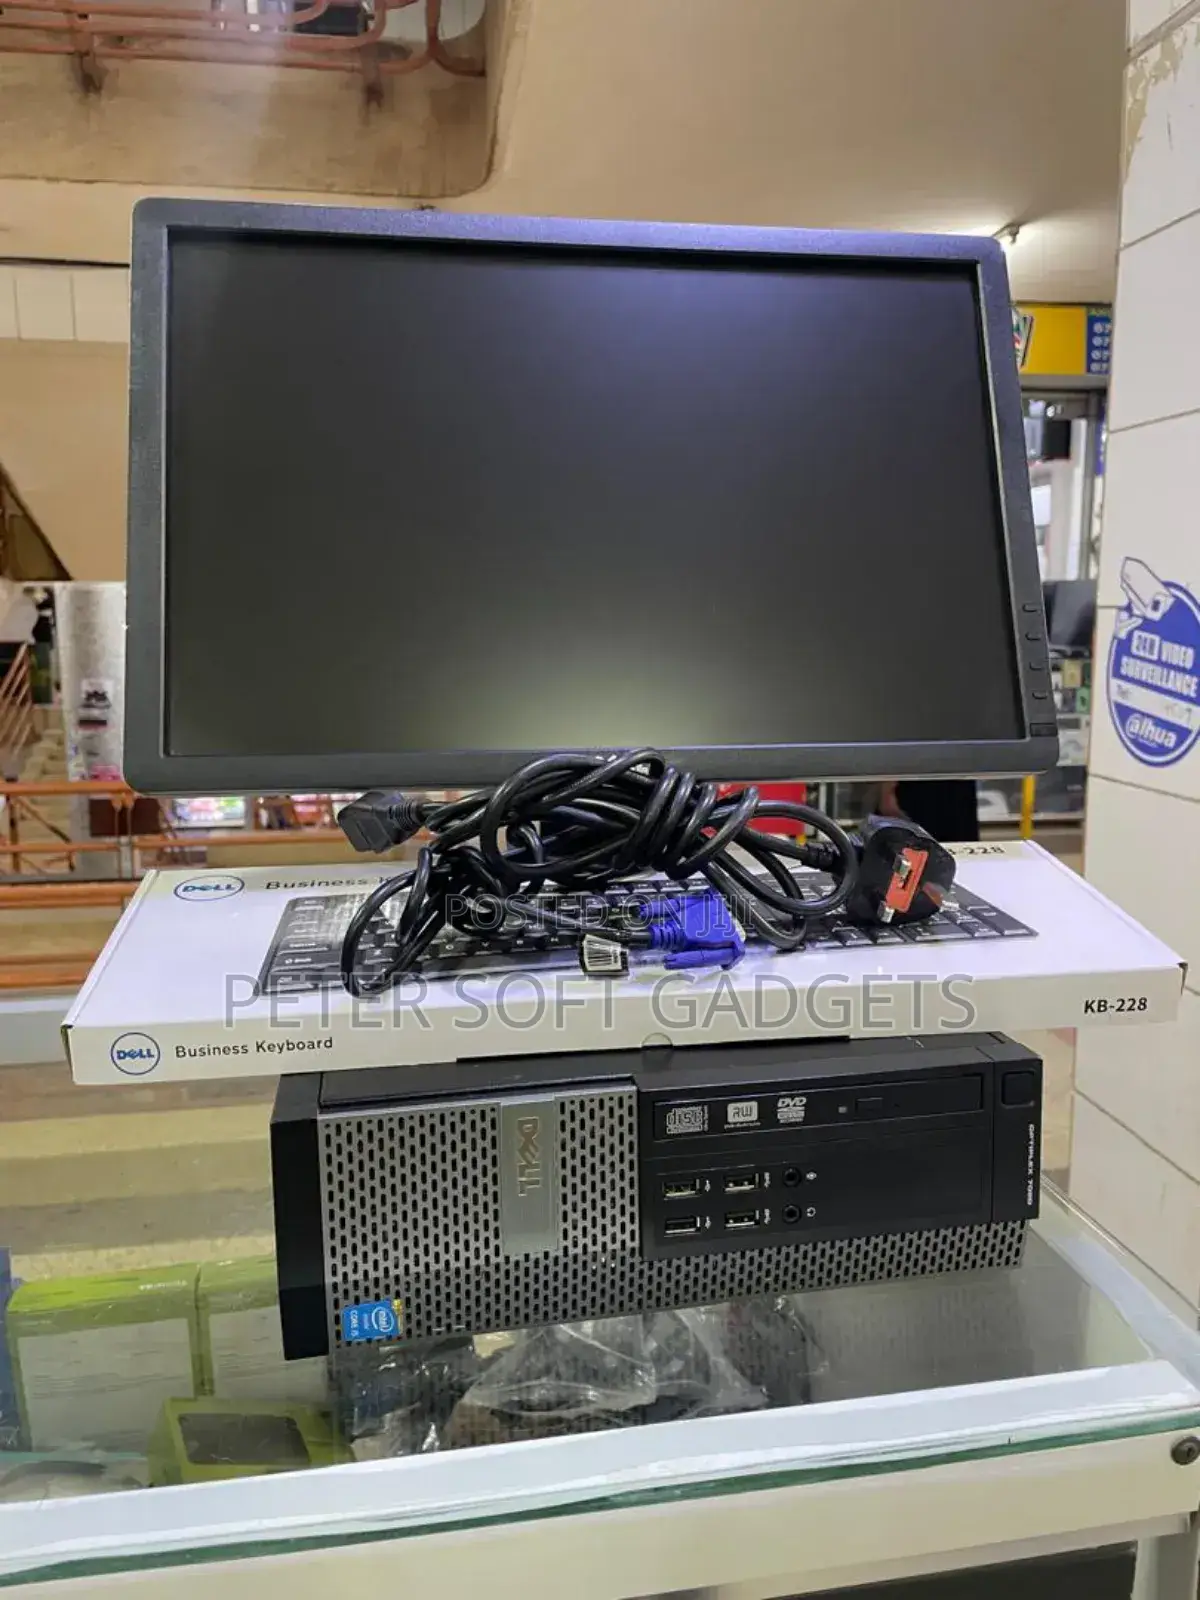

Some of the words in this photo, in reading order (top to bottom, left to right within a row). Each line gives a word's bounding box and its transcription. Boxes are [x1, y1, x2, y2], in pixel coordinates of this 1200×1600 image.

[1161, 640, 1195, 670] VIDEO
[1120, 655, 1198, 698] SURVEILLANCE
[264, 877, 369, 890] Business
[1083, 997, 1148, 1014] KB-228
[175, 1042, 249, 1059] Business
[255, 1036, 334, 1054] Keyboard
[778, 1096, 807, 1108] DVD
[517, 1115, 541, 1196] DELL
